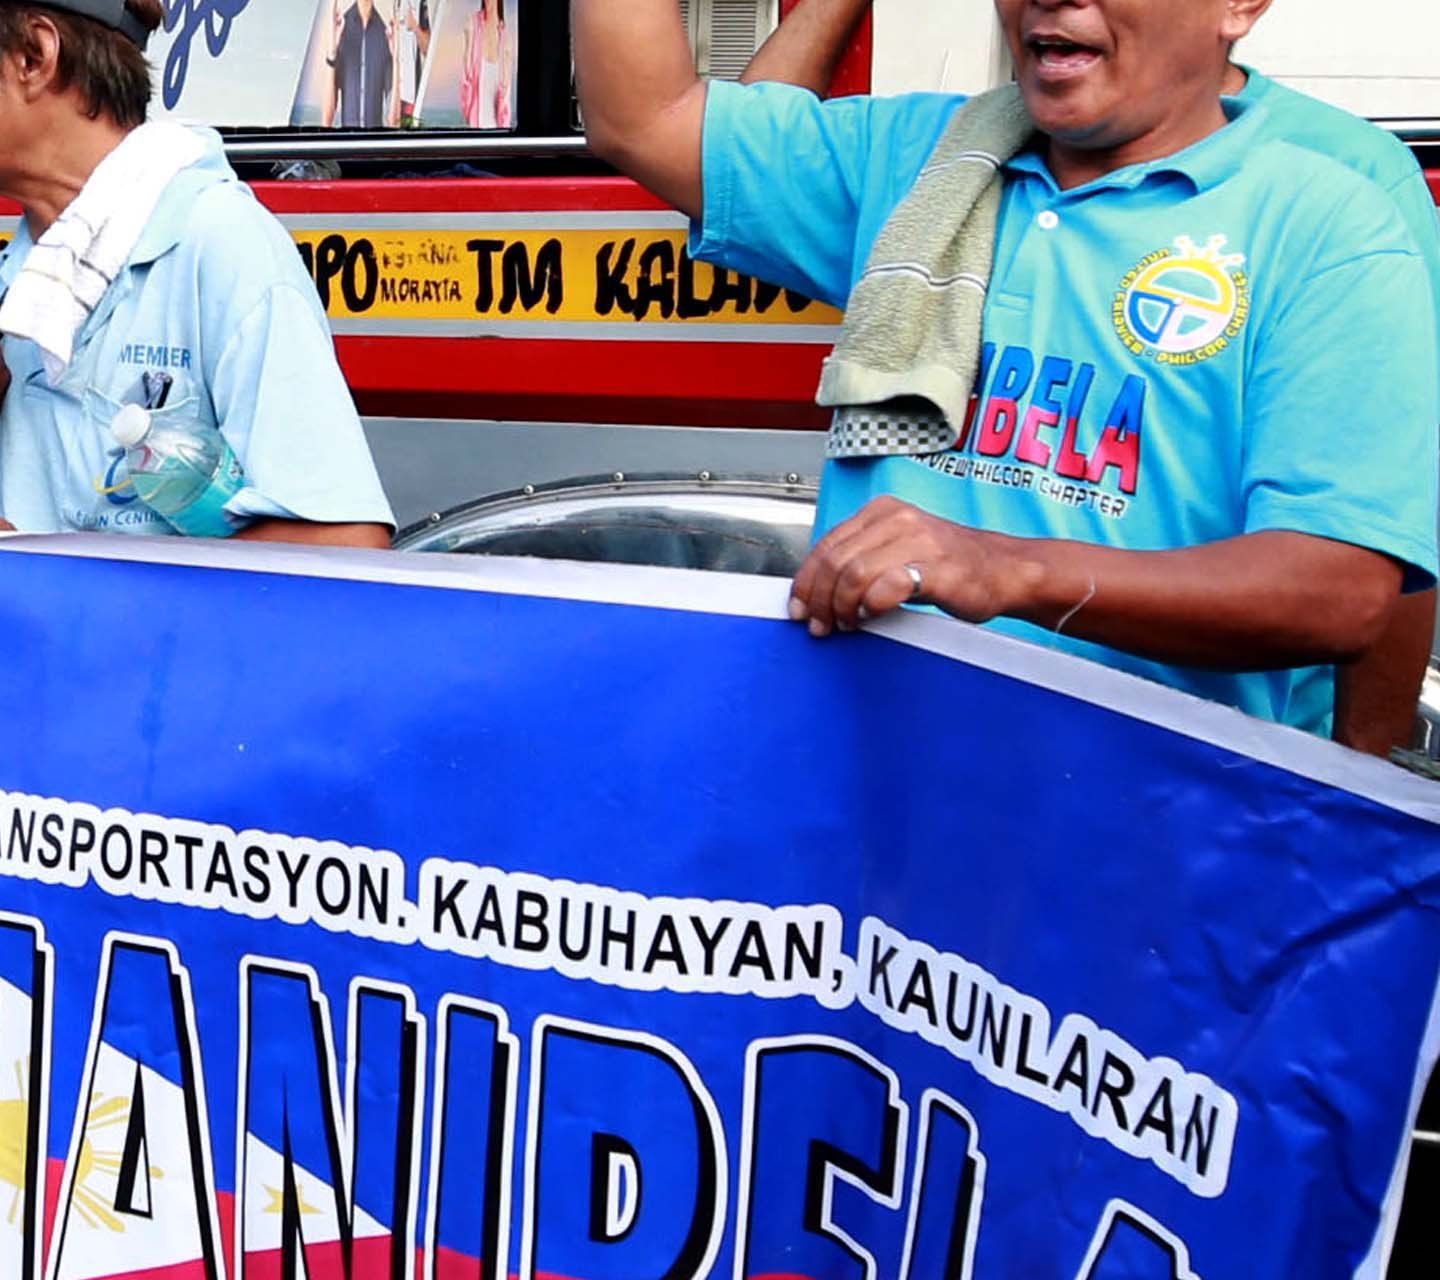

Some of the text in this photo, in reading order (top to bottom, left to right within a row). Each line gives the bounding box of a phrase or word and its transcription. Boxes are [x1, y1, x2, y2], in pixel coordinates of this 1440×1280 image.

[467, 238, 563, 314] TM
[954, 341, 1147, 496] IBELA
[1038, 475, 1126, 518] CHAPTER
[429, 870, 845, 995] KABUHAYAN,
[866, 934, 1216, 1177] KAUNLARAN
